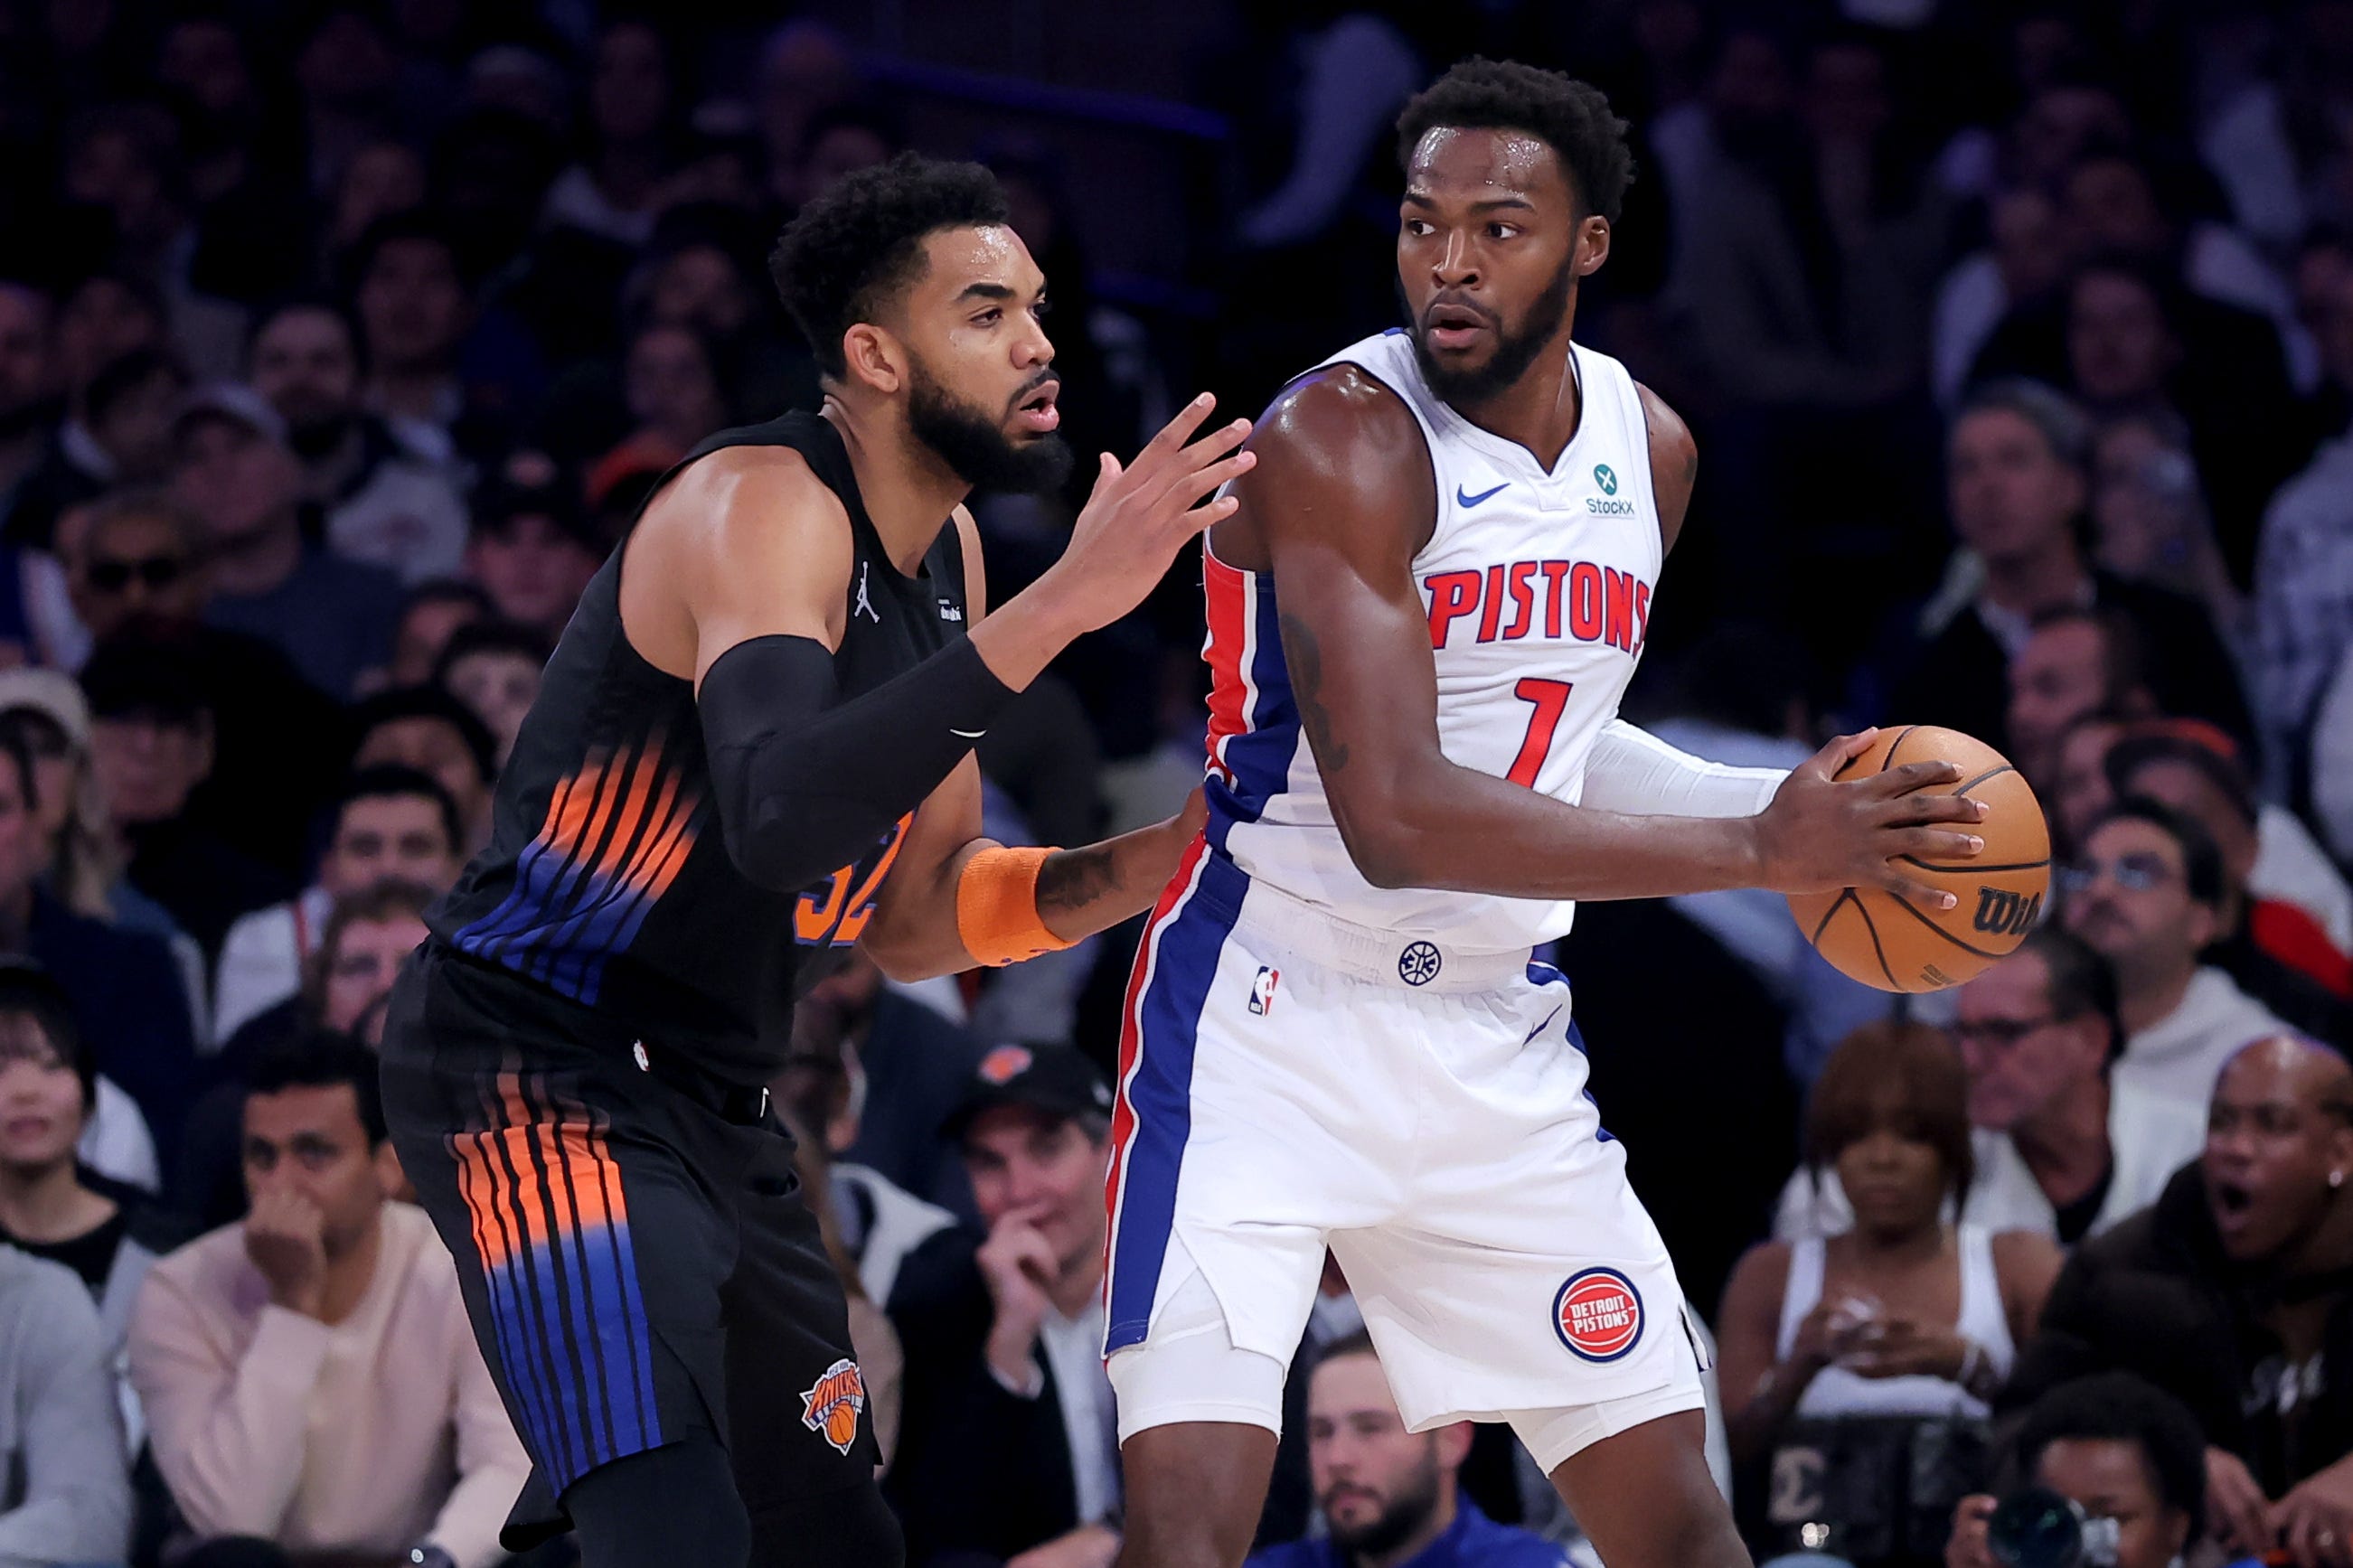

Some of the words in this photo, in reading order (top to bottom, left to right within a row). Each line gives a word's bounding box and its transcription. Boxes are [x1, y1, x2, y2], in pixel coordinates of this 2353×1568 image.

[1586, 498, 1634, 514] StockX
[1424, 559, 1650, 660] PISTONS
[1506, 677, 1573, 789] 7
[1569, 1295, 1624, 1319] DETROIT
[1572, 1310, 1630, 1335] PISTONS
